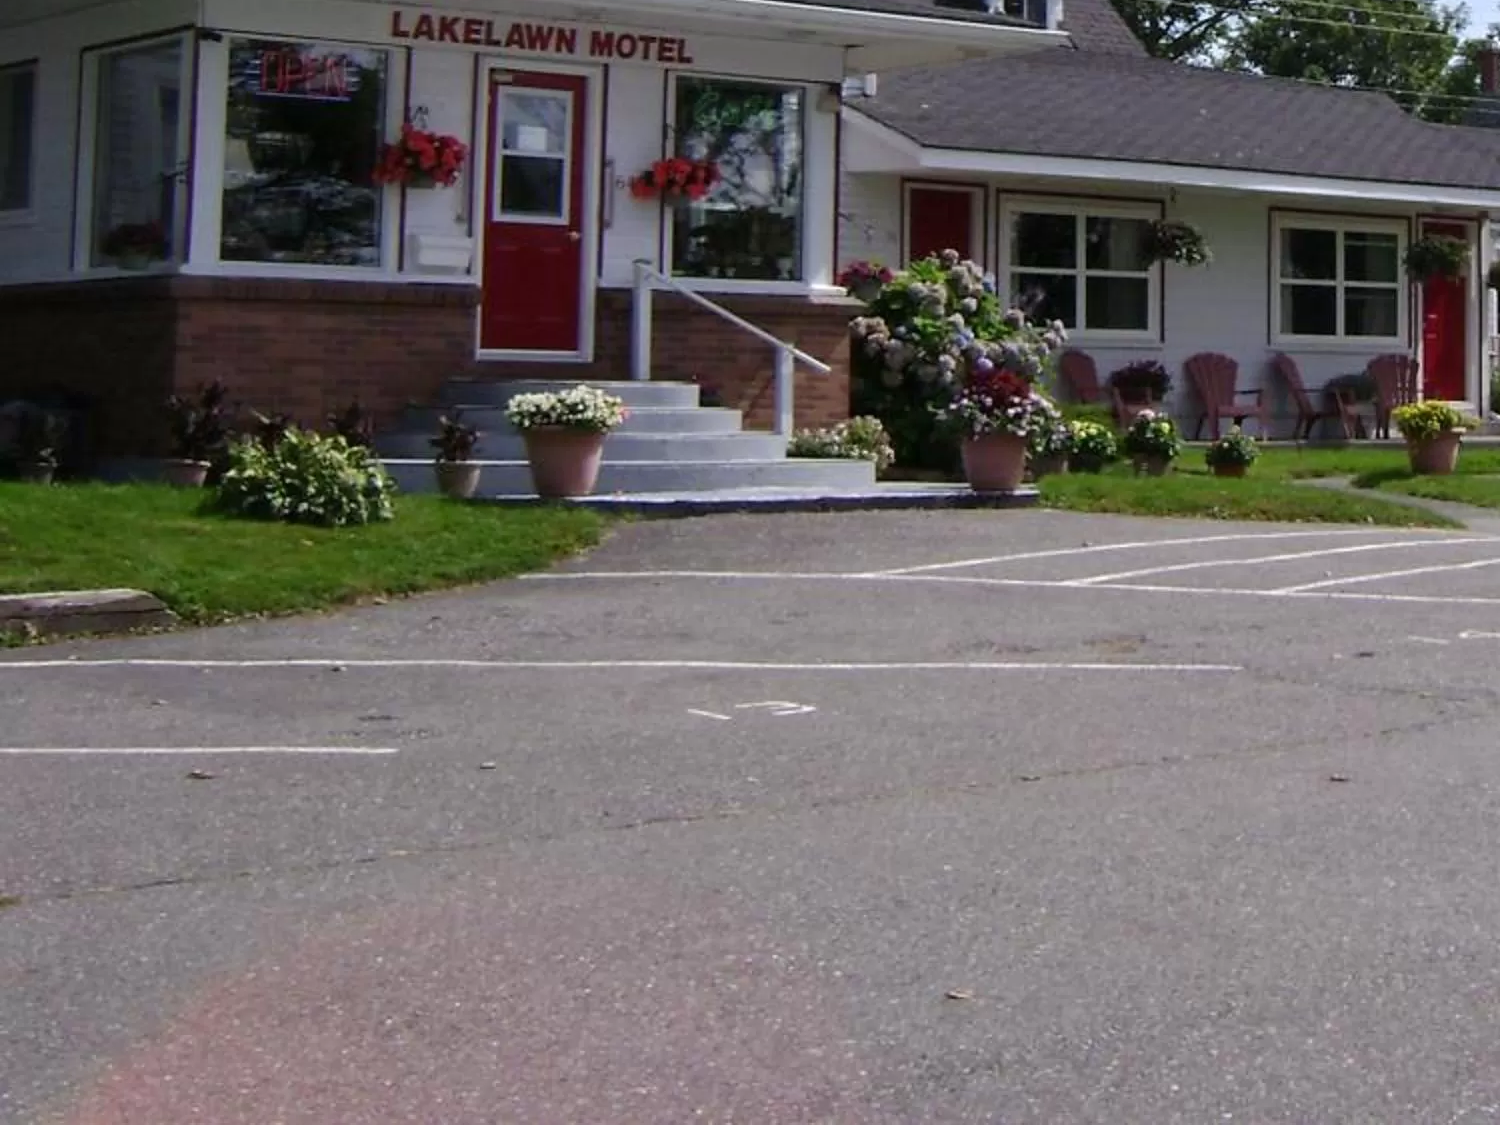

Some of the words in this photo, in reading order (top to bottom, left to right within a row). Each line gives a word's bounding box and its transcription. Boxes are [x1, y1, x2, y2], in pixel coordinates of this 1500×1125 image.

[391, 10, 578, 55] LAKELAWN
[588, 30, 694, 64] MOTEL
[261, 49, 349, 97] OPEN
